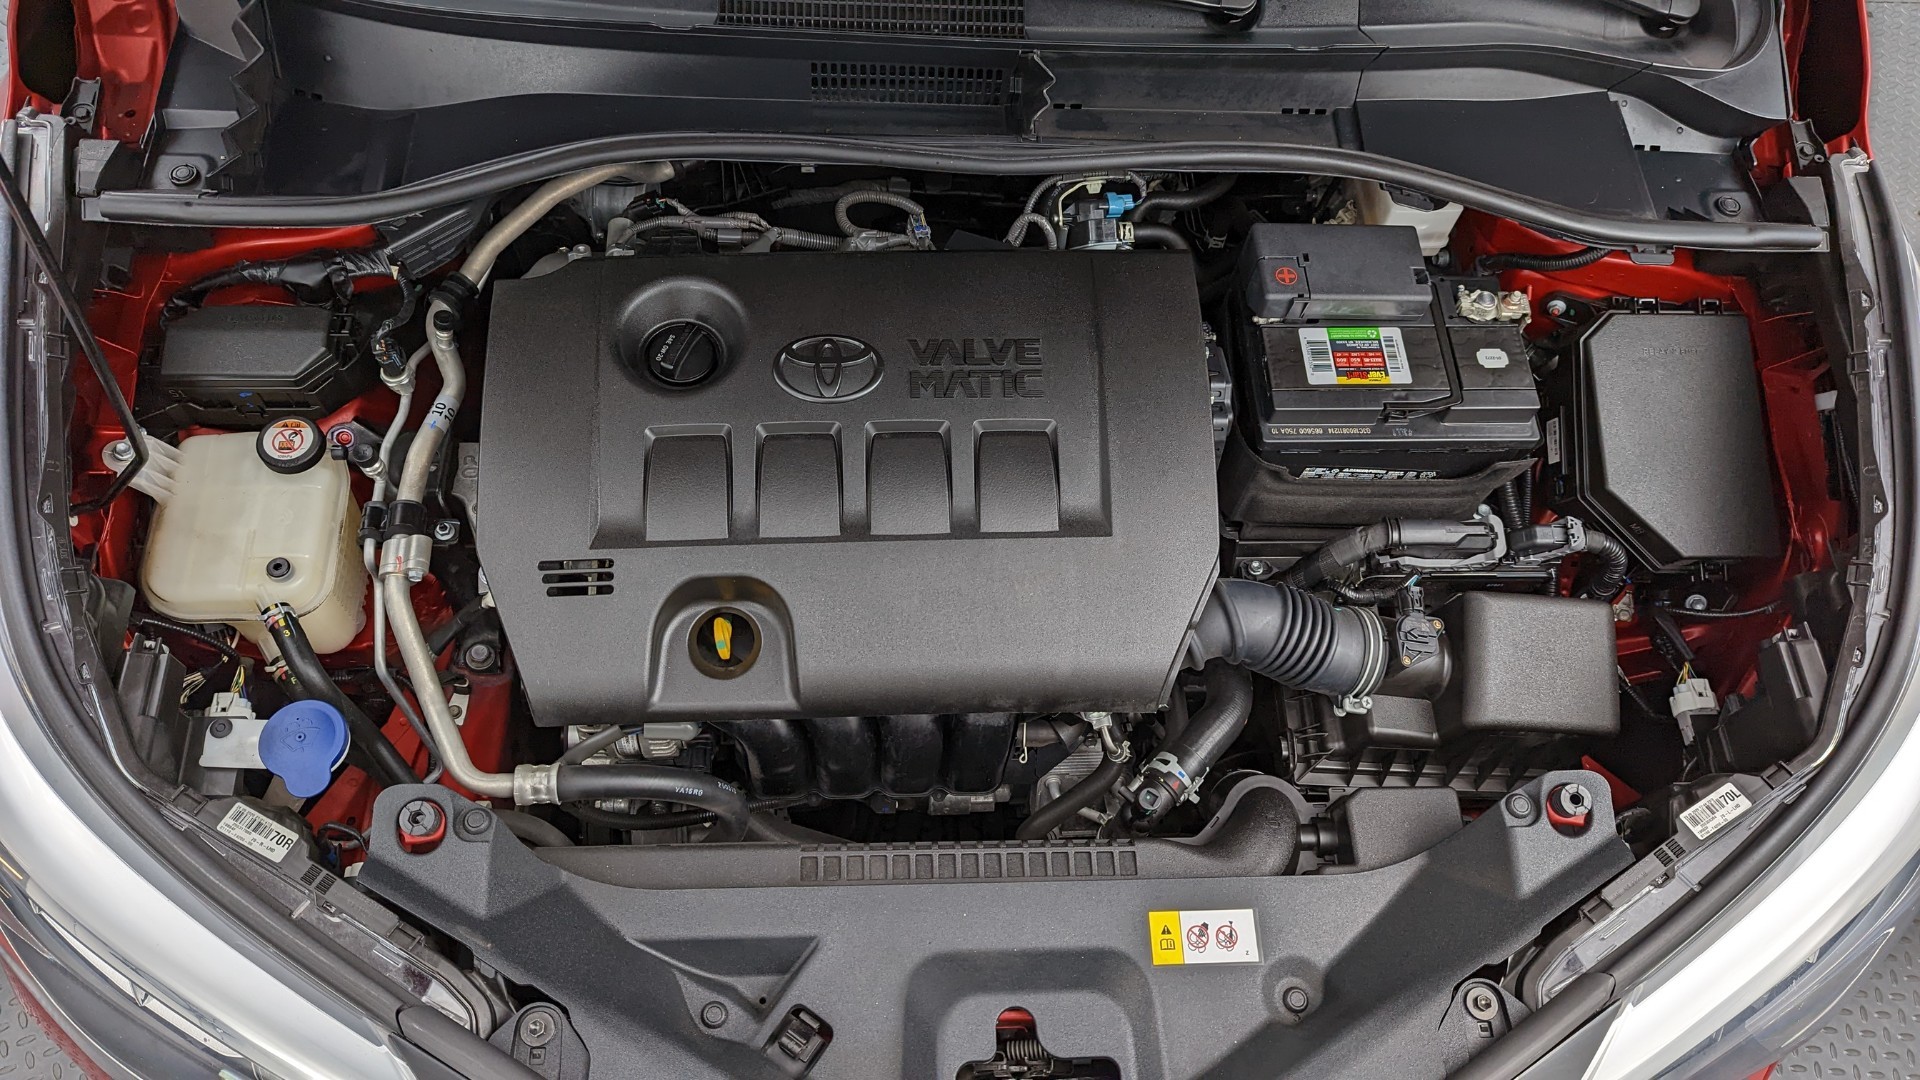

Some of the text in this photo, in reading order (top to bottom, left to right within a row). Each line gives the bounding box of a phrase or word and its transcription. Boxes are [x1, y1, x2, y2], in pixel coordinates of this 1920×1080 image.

[655, 334, 676, 361] SAE 0W-20
[906, 338, 1043, 366] VALVE
[909, 369, 1045, 399] MATIC
[432, 402, 447, 416] 10
[444, 407, 456, 422] 10
[282, 629, 291, 637] 3
[1719, 789, 1742, 805] 70L
[269, 830, 294, 851] 70R
